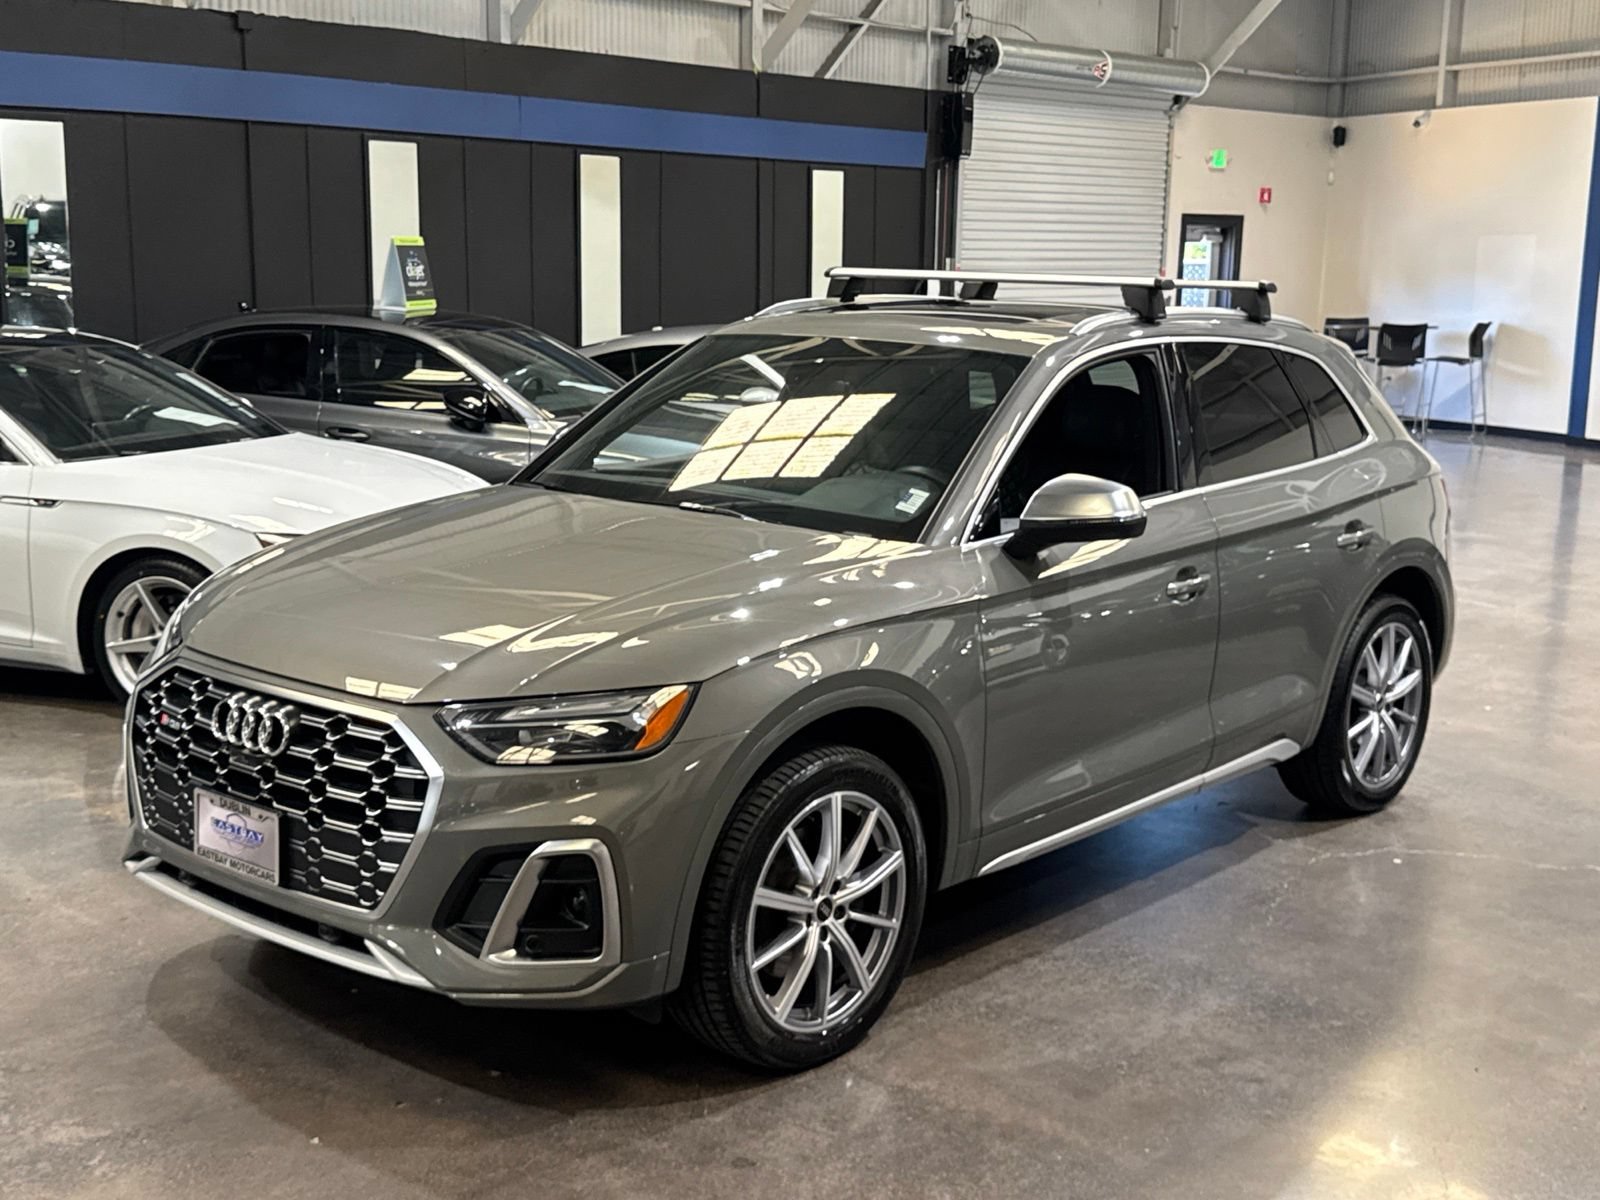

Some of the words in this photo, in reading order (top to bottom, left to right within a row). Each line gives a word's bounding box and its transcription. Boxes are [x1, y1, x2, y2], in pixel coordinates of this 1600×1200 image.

[219, 797, 251, 816] DUBLIN
[197, 847, 228, 865] EASTBAY
[229, 859, 276, 883] MOTORCARS
